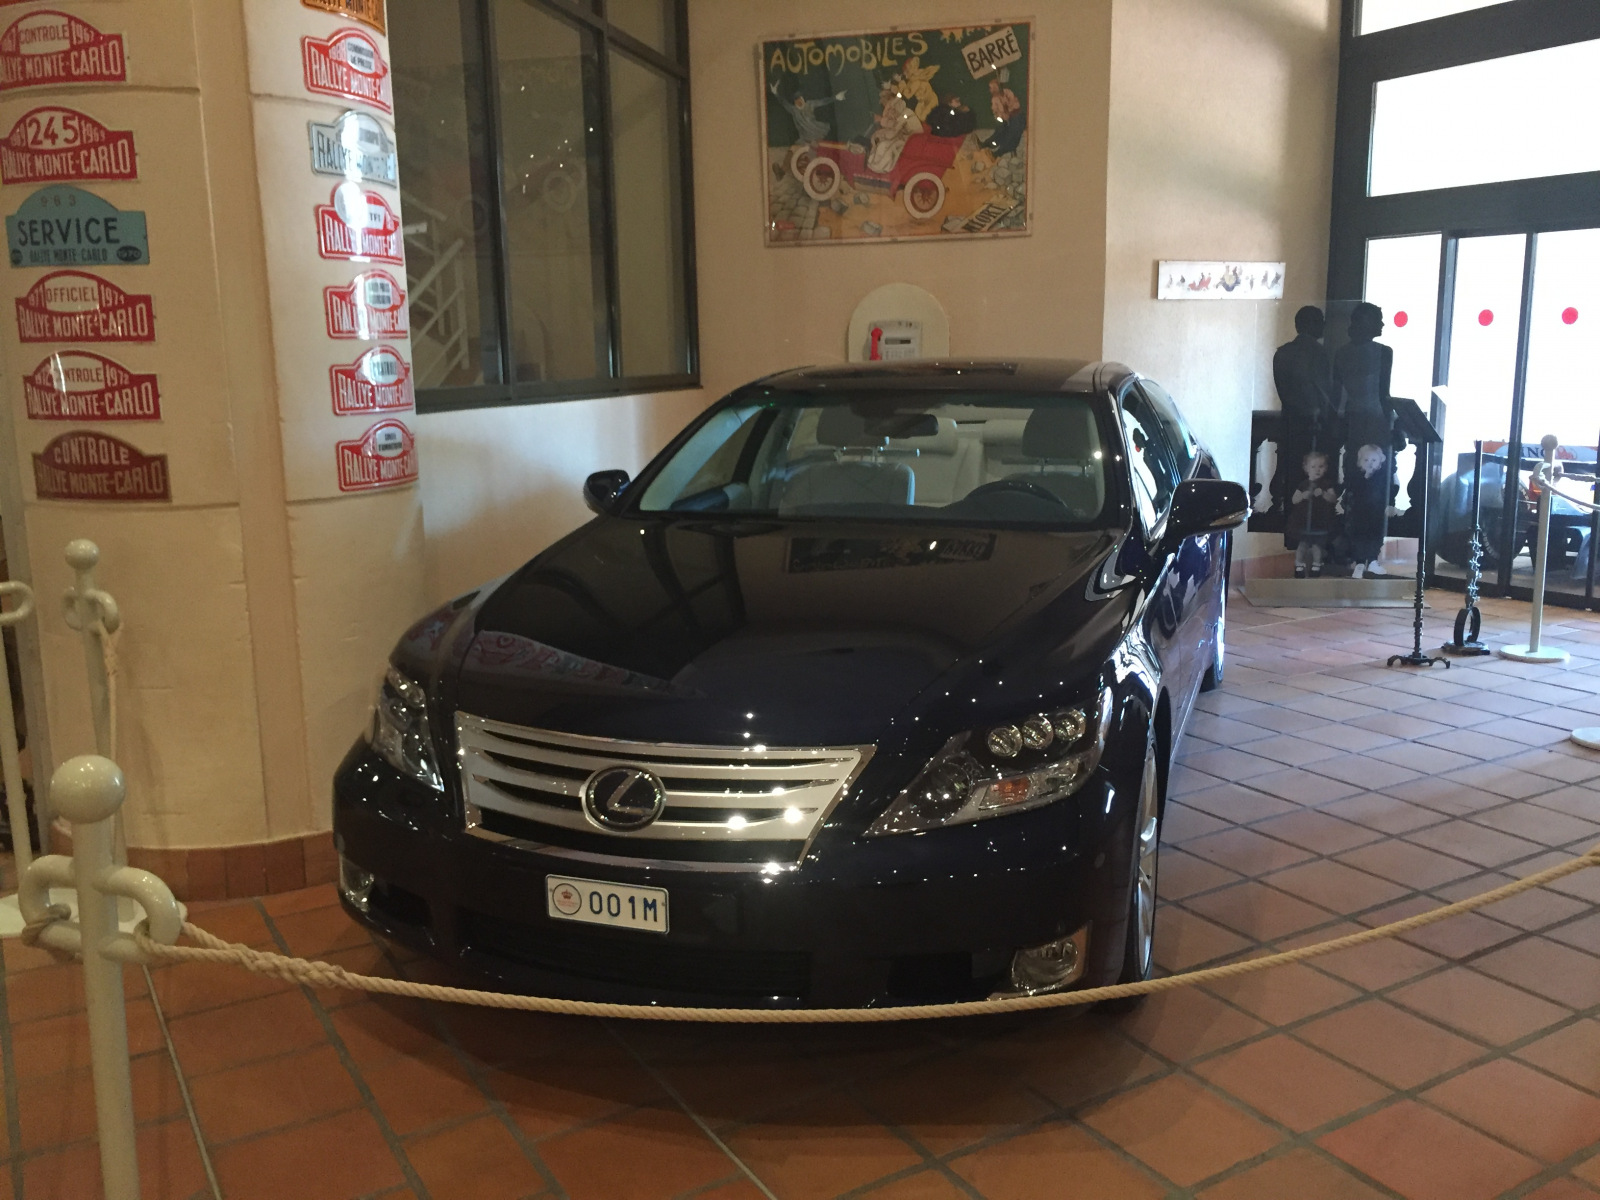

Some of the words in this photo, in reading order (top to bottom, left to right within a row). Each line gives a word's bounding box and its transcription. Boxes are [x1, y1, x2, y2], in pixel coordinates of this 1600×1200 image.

[19, 24, 69, 45] CONTROLE
[770, 32, 928, 75] AUTOMOBILES
[967, 30, 1018, 72] BARRÉ
[311, 45, 348, 92] RALLYE
[28, 116, 79, 146] 245
[17, 217, 120, 246] SERVICE
[81, 248, 108, 262] CARLO
[47, 286, 96, 303] OFFICIEL
[18, 304, 51, 338] RALLYE
[27, 383, 60, 415] RALLYE
[337, 372, 374, 408] RALLYE
[53, 437, 130, 465] CONTROLE
[344, 449, 379, 485] RALLYE
[589, 891, 657, 922] 001M
